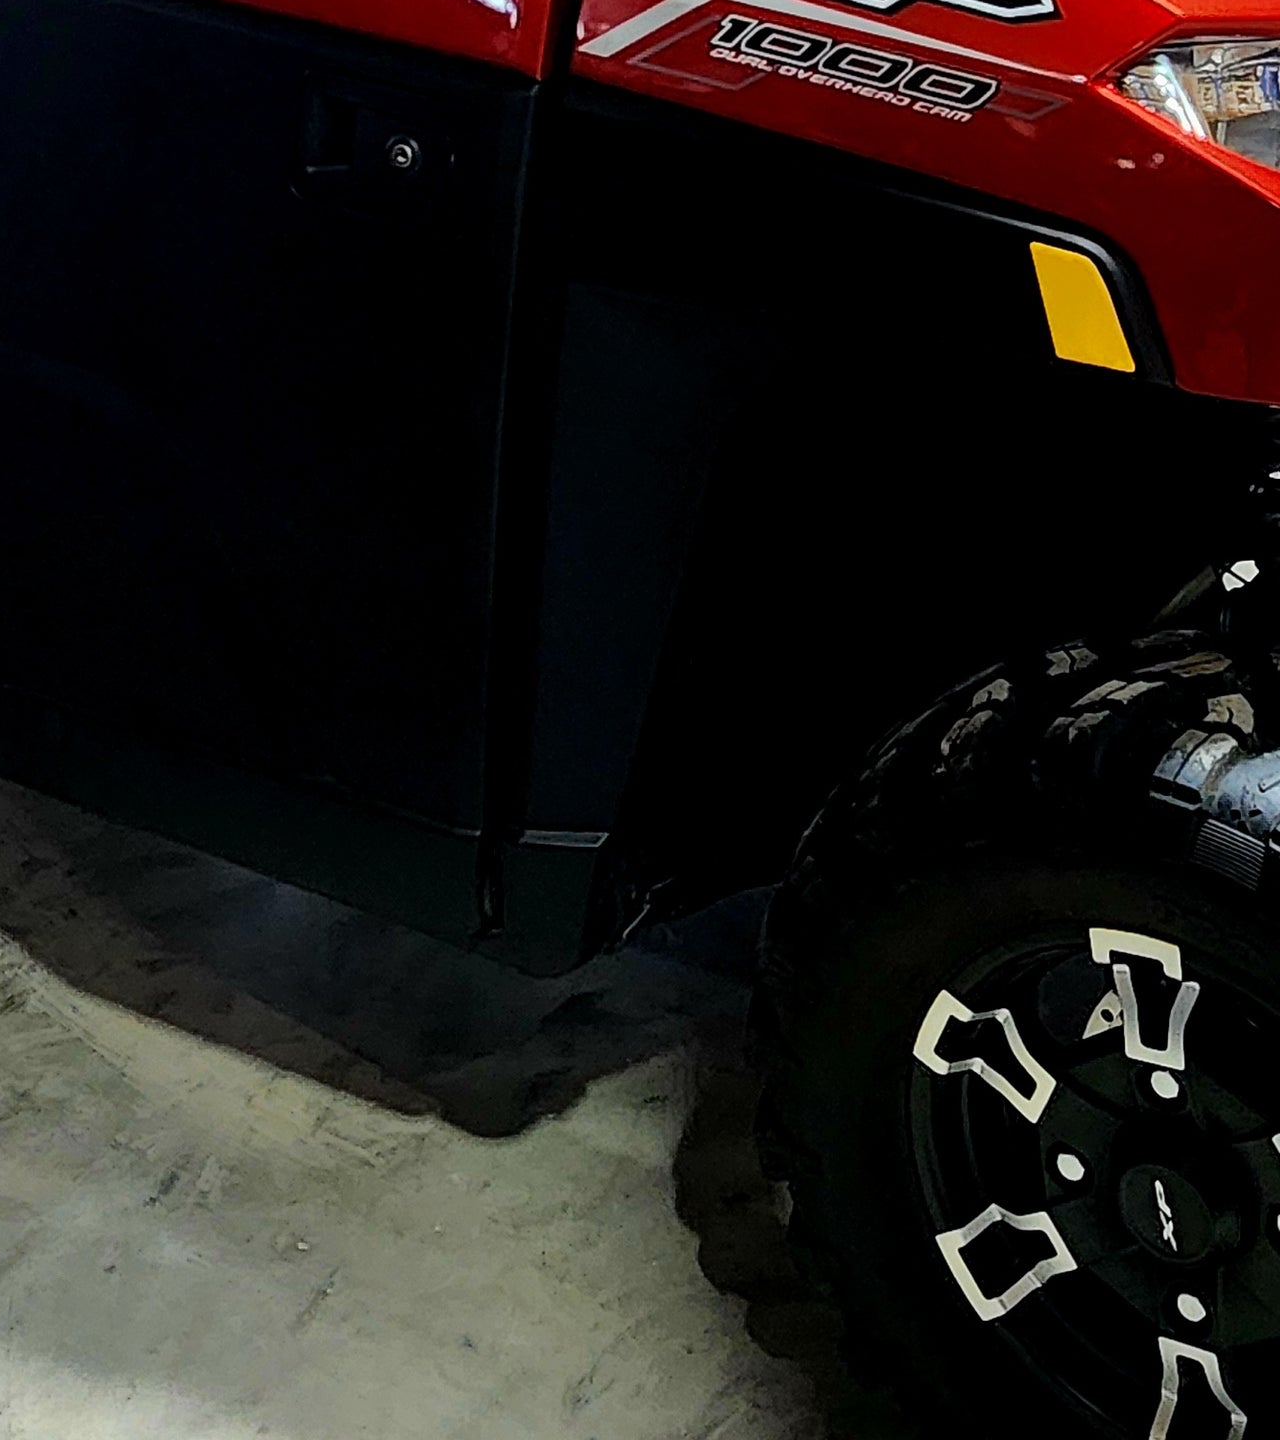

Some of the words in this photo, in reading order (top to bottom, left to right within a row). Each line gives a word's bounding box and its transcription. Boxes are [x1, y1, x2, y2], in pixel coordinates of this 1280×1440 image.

[709, 47, 774, 72] DUAL
[778, 64, 912, 107] OVERHEAD
[912, 98, 973, 123] CAM
[710, 13, 999, 110] 1000
[1154, 1179, 1178, 1252] XP
